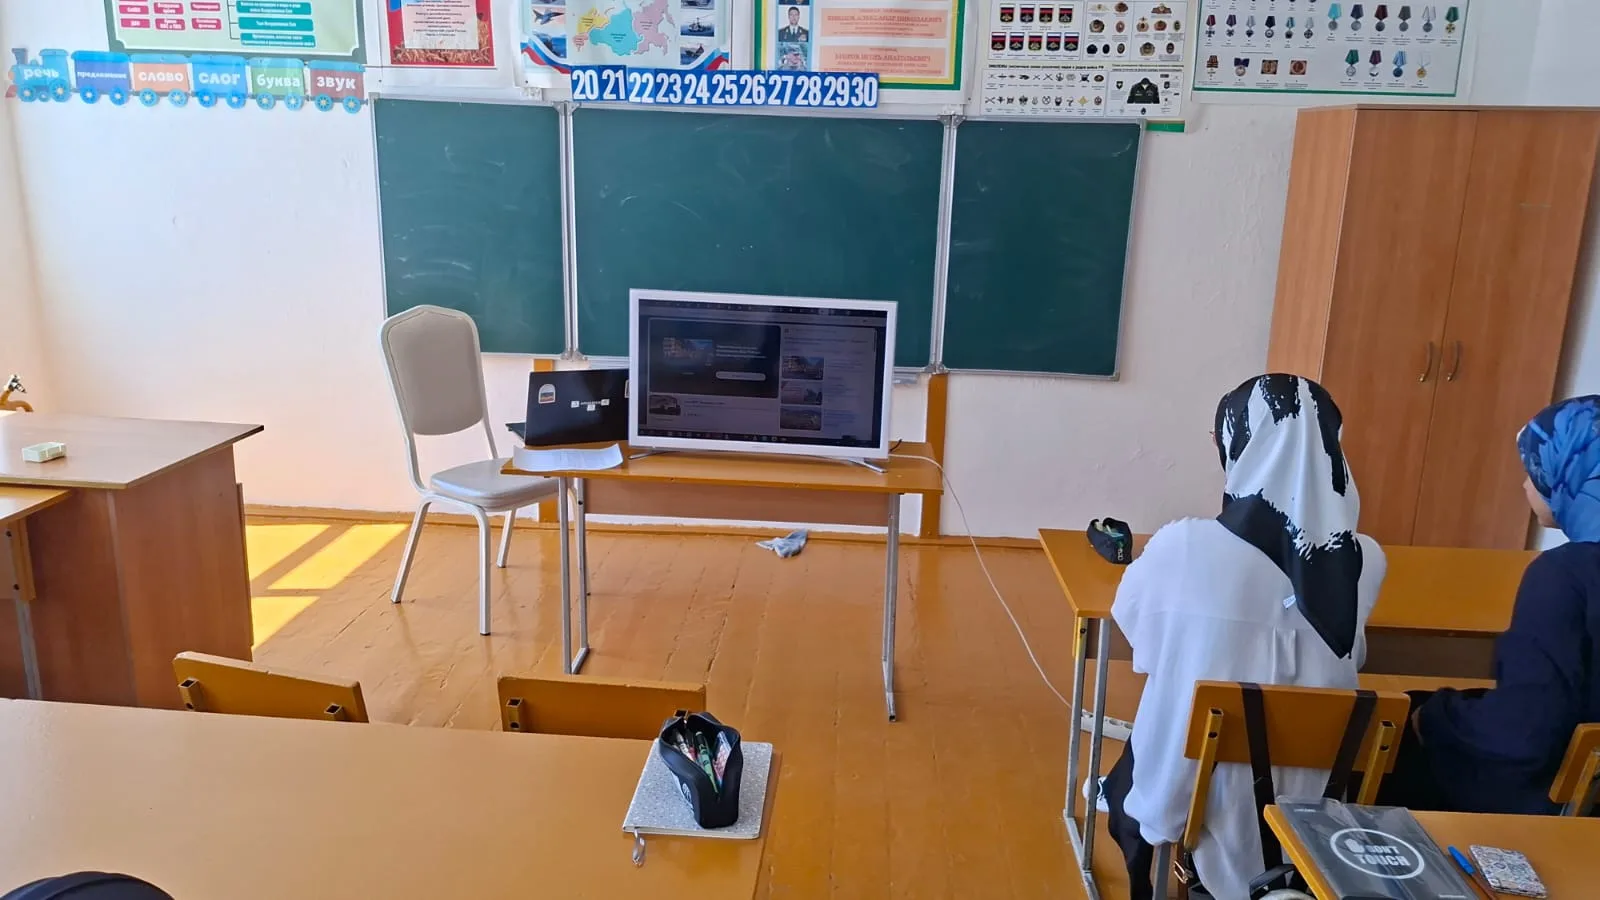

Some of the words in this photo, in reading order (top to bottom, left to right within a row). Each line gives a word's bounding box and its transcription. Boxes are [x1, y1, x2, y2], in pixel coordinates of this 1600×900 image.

[23, 68, 60, 80] речь
[138, 71, 184, 82] слово
[198, 73, 240, 85] слог
[256, 74, 299, 89] буква
[316, 76, 357, 91] звук
[572, 69, 599, 100] 20
[602, 69, 626, 100] 21
[628, 72, 654, 103] 22
[656, 73, 682, 104] 23
[684, 74, 710, 104] 24
[712, 74, 738, 105] 25
[740, 74, 766, 105] 26
[768, 74, 794, 105] 27
[795, 75, 822, 106] 28
[823, 76, 850, 106] 29
[850, 76, 878, 107] 30
[1353, 854, 1411, 866] TOUCH
